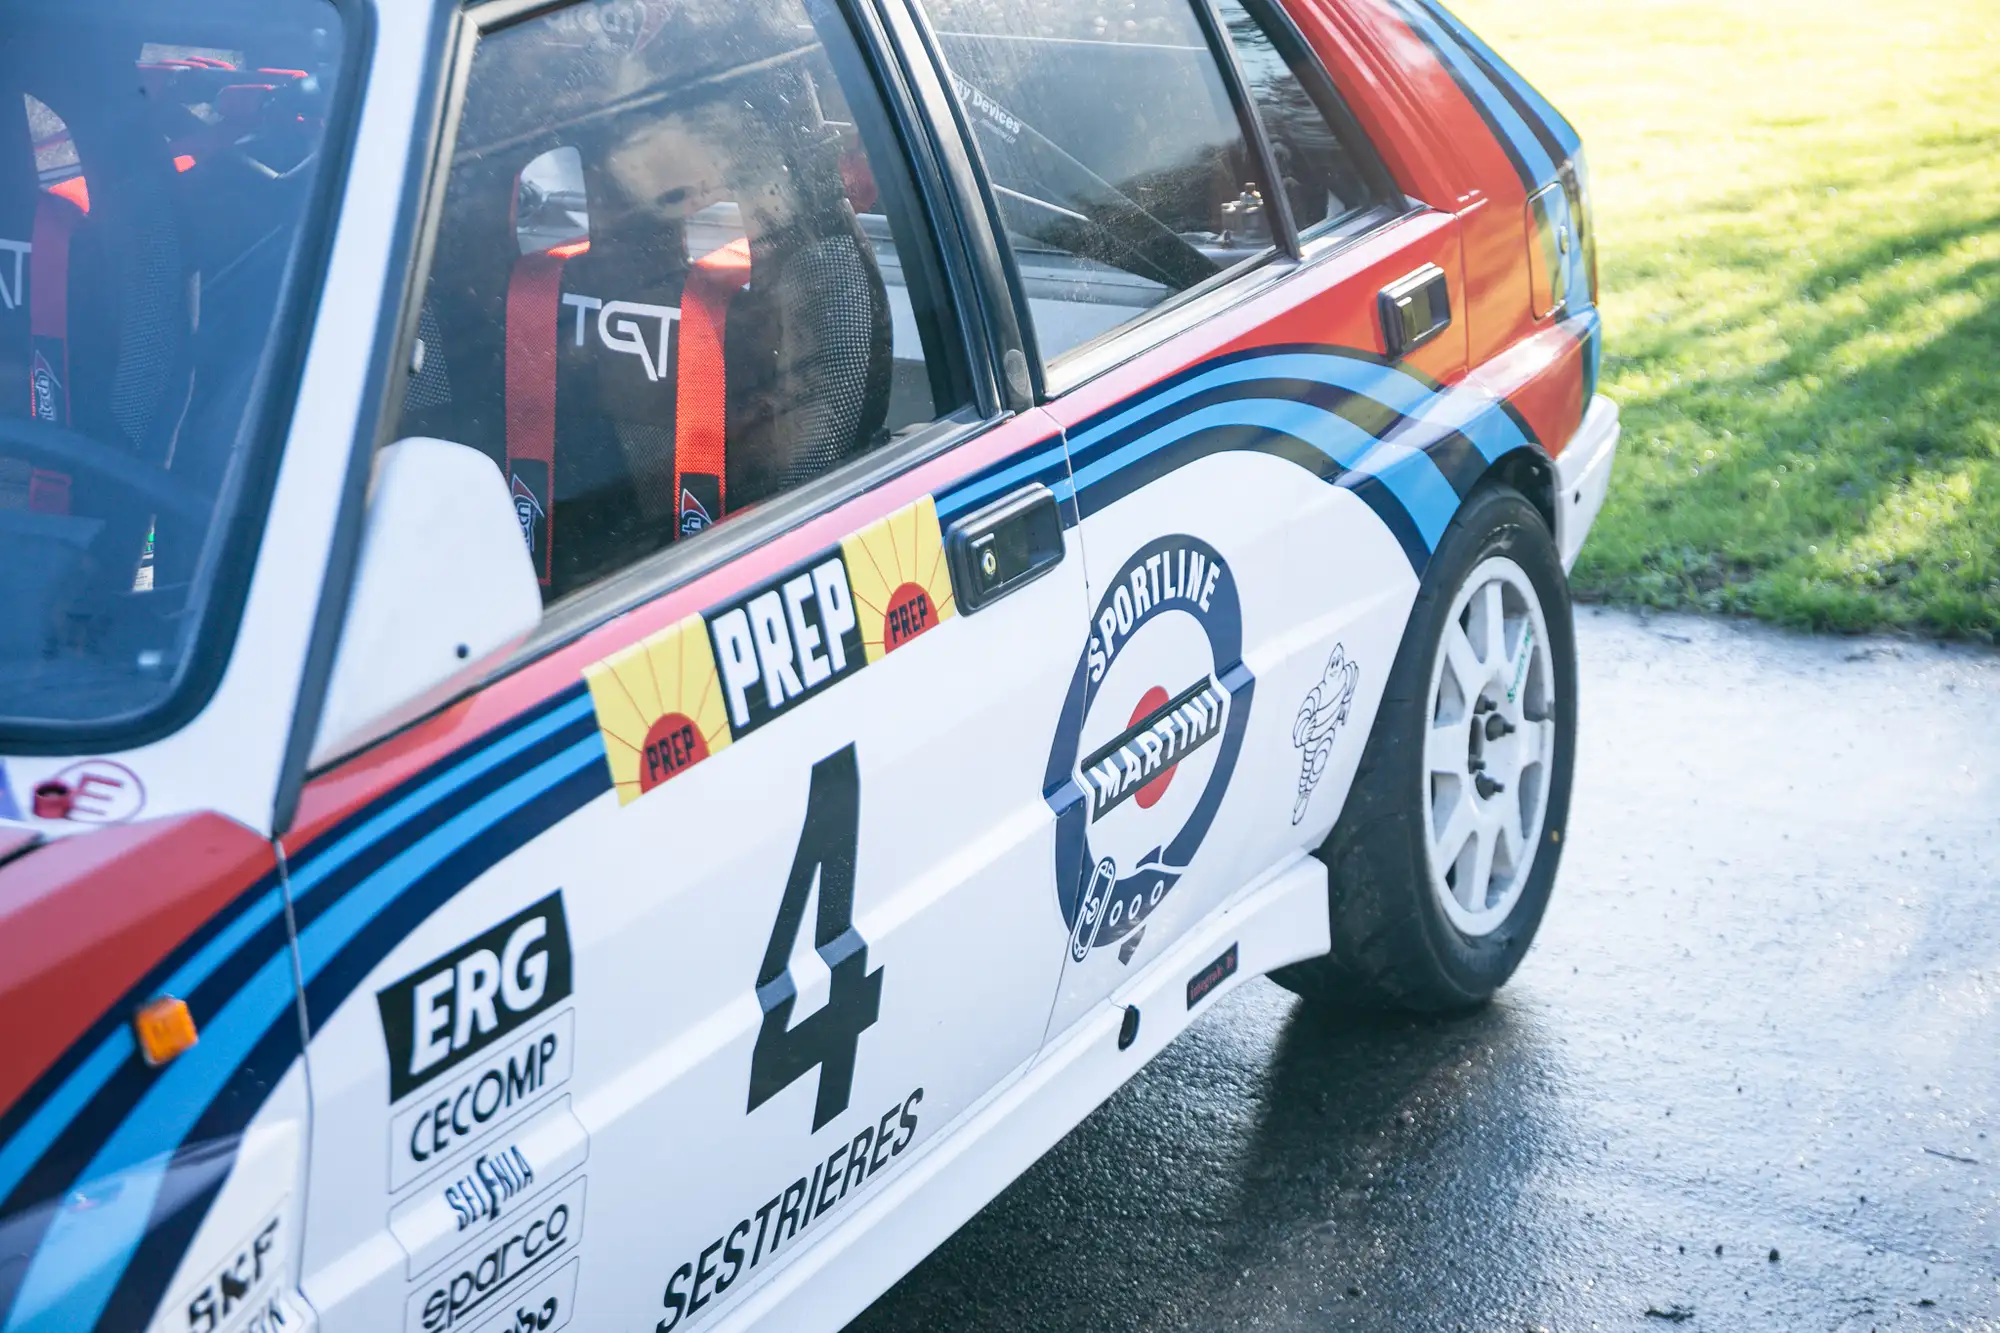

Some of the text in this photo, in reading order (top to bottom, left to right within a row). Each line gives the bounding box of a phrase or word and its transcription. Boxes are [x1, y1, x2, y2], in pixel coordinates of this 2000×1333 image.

[971, 90, 1022, 134] Devices
[562, 292, 682, 382] TGT
[711, 556, 856, 729] PREP
[889, 594, 929, 644] PREP
[1089, 548, 1221, 684] SPORTLINE
[645, 725, 696, 782] PREP
[1088, 689, 1223, 808] MARTINI
[409, 914, 549, 1077] ERG
[746, 740, 885, 1136] 4
[410, 1032, 558, 1162] CECOMP
[445, 1145, 533, 1232] SELENIA
[655, 1087, 924, 1333] SESTRIERES
[188, 1215, 279, 1333] SKF
[422, 1203, 569, 1329] sparco
